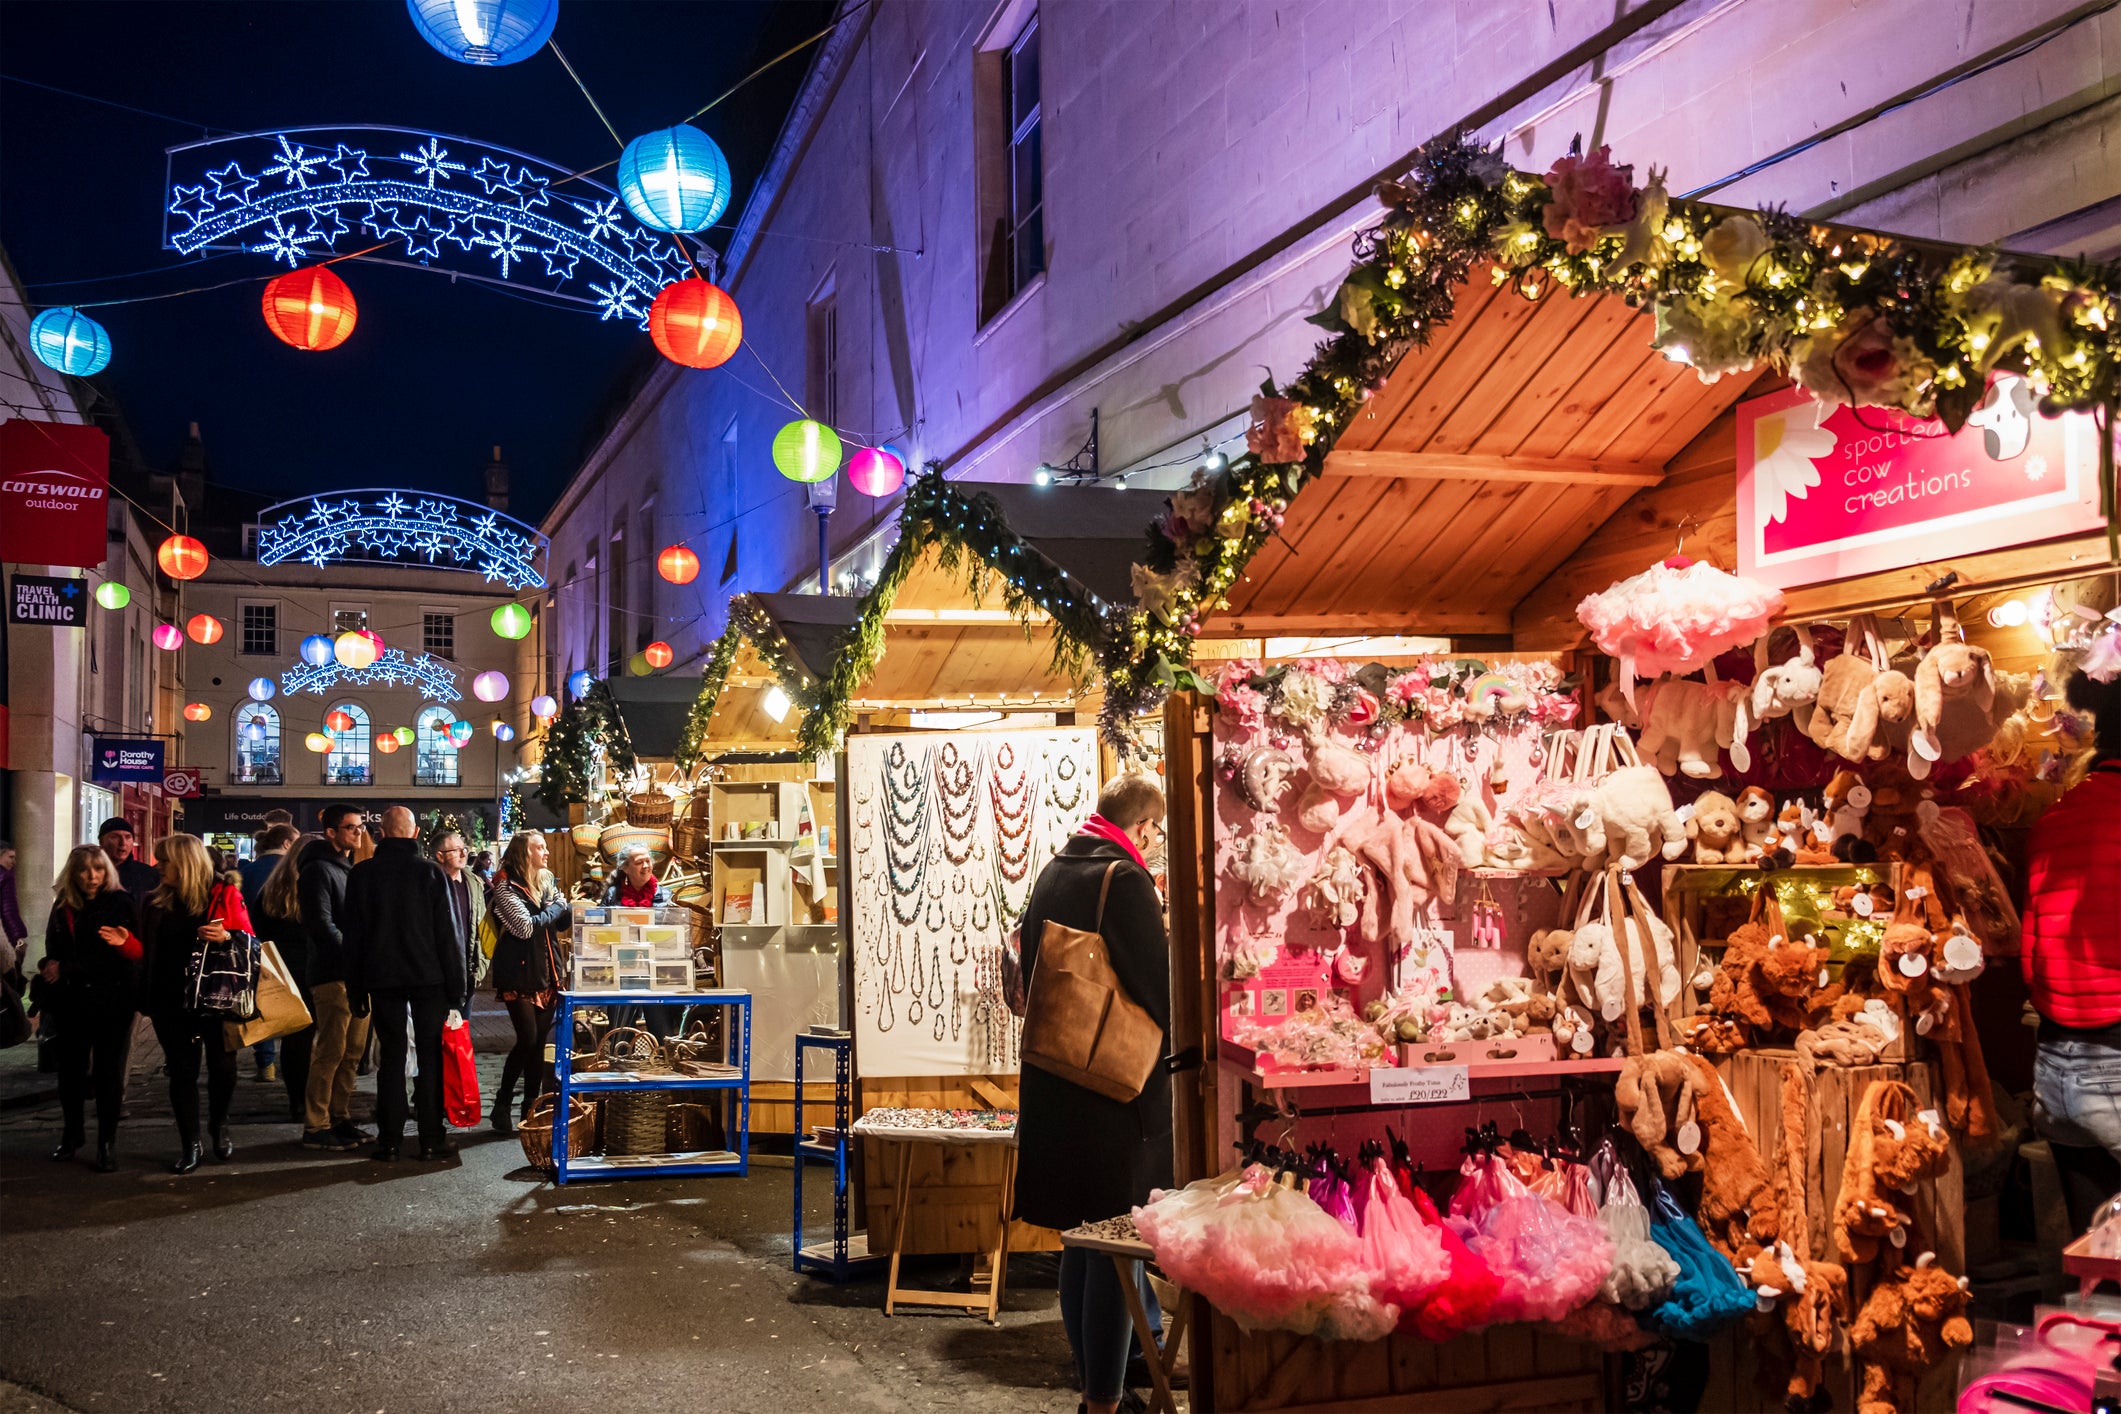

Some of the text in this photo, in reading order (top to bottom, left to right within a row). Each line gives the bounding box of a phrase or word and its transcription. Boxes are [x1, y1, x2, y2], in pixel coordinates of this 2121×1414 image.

[1843, 461, 1892, 486] cow
[2, 481, 103, 499] COTSWOLD
[1844, 469, 1971, 513] creations
[25, 499, 79, 511] outdoor
[16, 584, 55, 596] TRAVEL
[16, 594, 59, 605] HEALTH
[16, 603, 75, 621] CLINIC
[120, 750, 155, 760] Dorothy
[120, 757, 148, 765] House
[224, 812, 239, 820] Life
[1409, 1089, 1448, 1100] £20/£22
